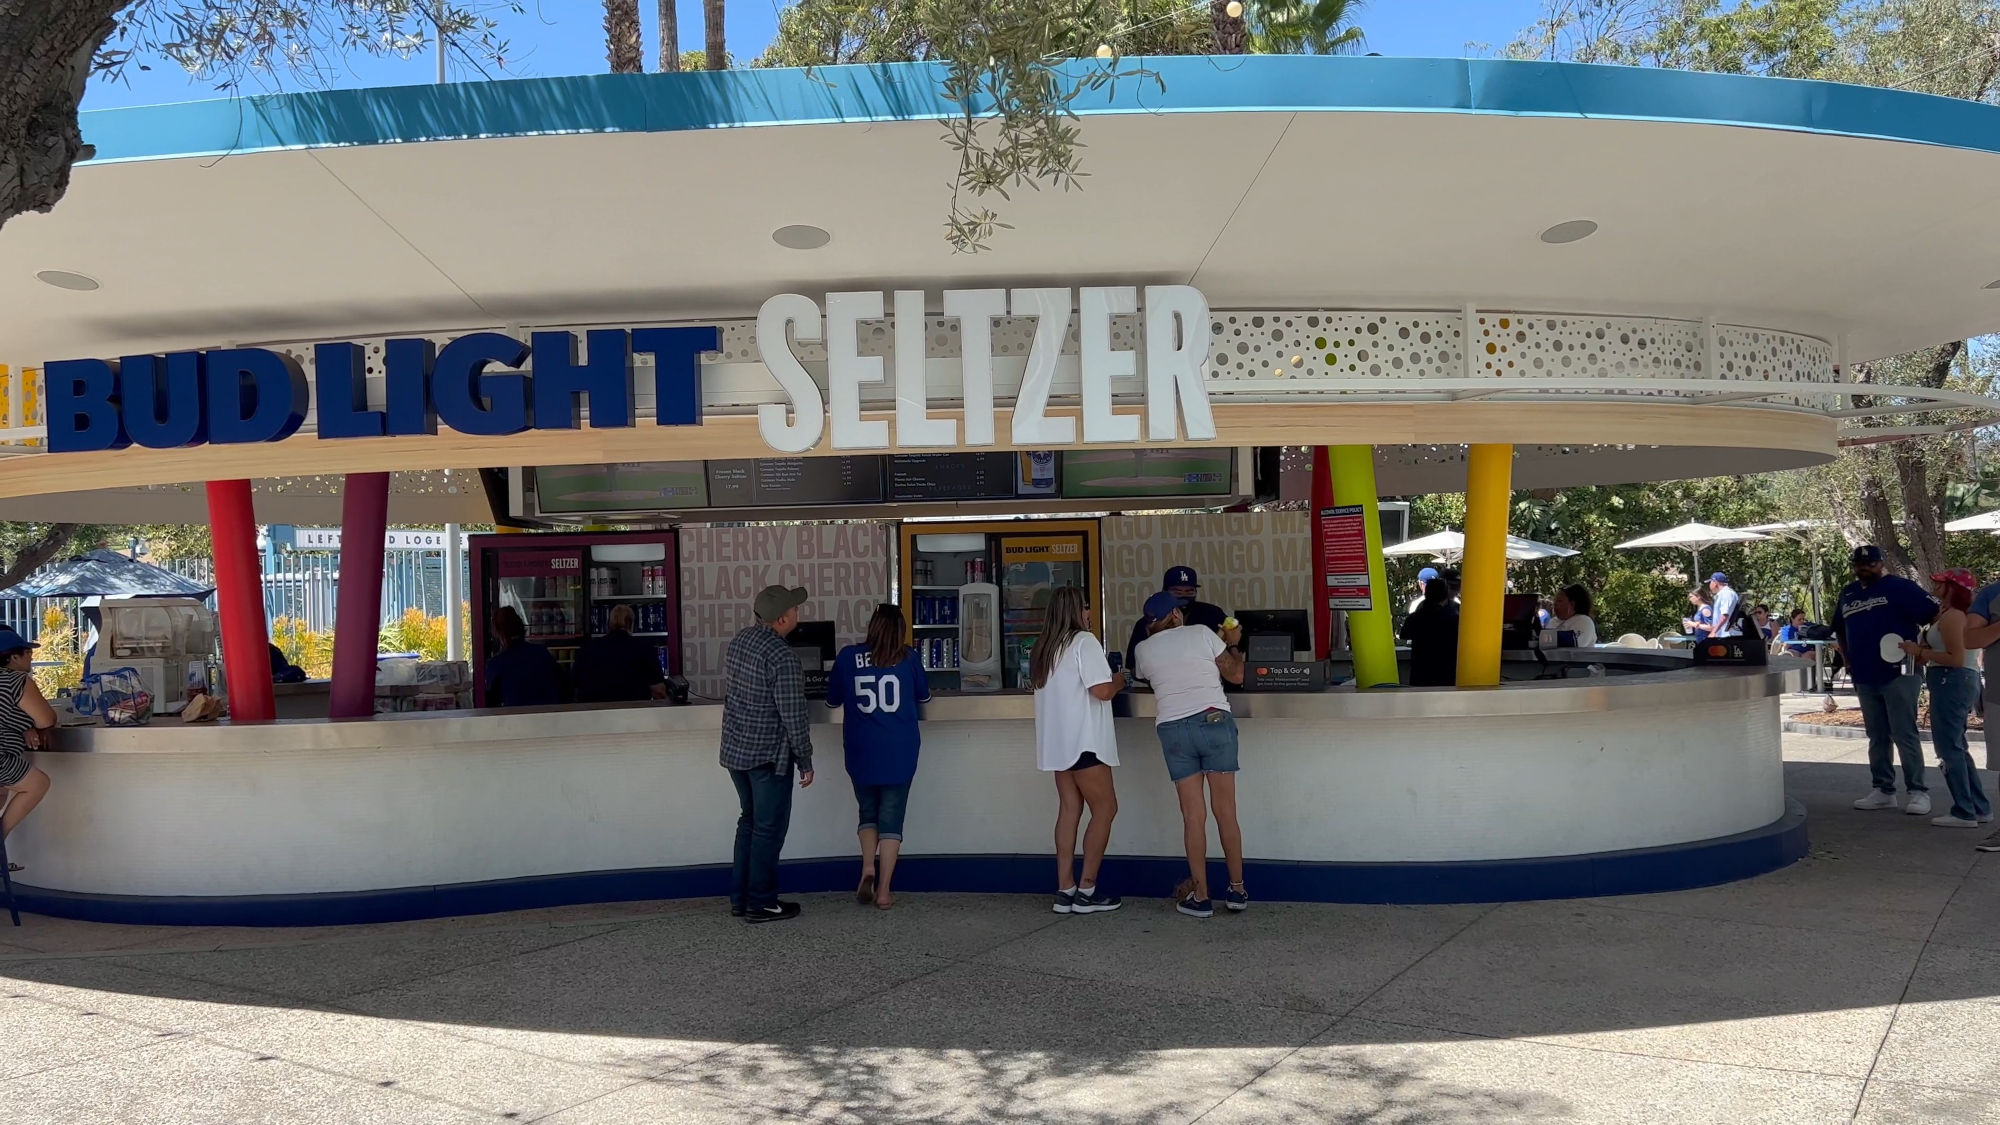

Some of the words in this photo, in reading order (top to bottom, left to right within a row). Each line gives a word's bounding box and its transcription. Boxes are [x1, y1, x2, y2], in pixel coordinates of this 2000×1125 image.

[44, 347, 308, 453] BUD
[314, 326, 724, 440] LIGHT
[756, 285, 1218, 453] SELTZER
[680, 527, 790, 563] CHERRY
[796, 524, 887, 560] BLACK
[1159, 512, 1265, 539] MANGO
[551, 557, 579, 569] SELTZER
[1005, 546, 1024, 554] BUD
[1025, 545, 1050, 554] LIGHT
[1051, 543, 1078, 554] SELTZER
[1161, 538, 1266, 576] MANGO
[681, 565, 771, 601] BLACK
[778, 561, 888, 597] CHERRY
[1197, 577, 1267, 610] ANGO
[683, 602, 750, 639] CHER
[1270, 667, 1283, 675] Tap
[854, 674, 900, 714] 50
